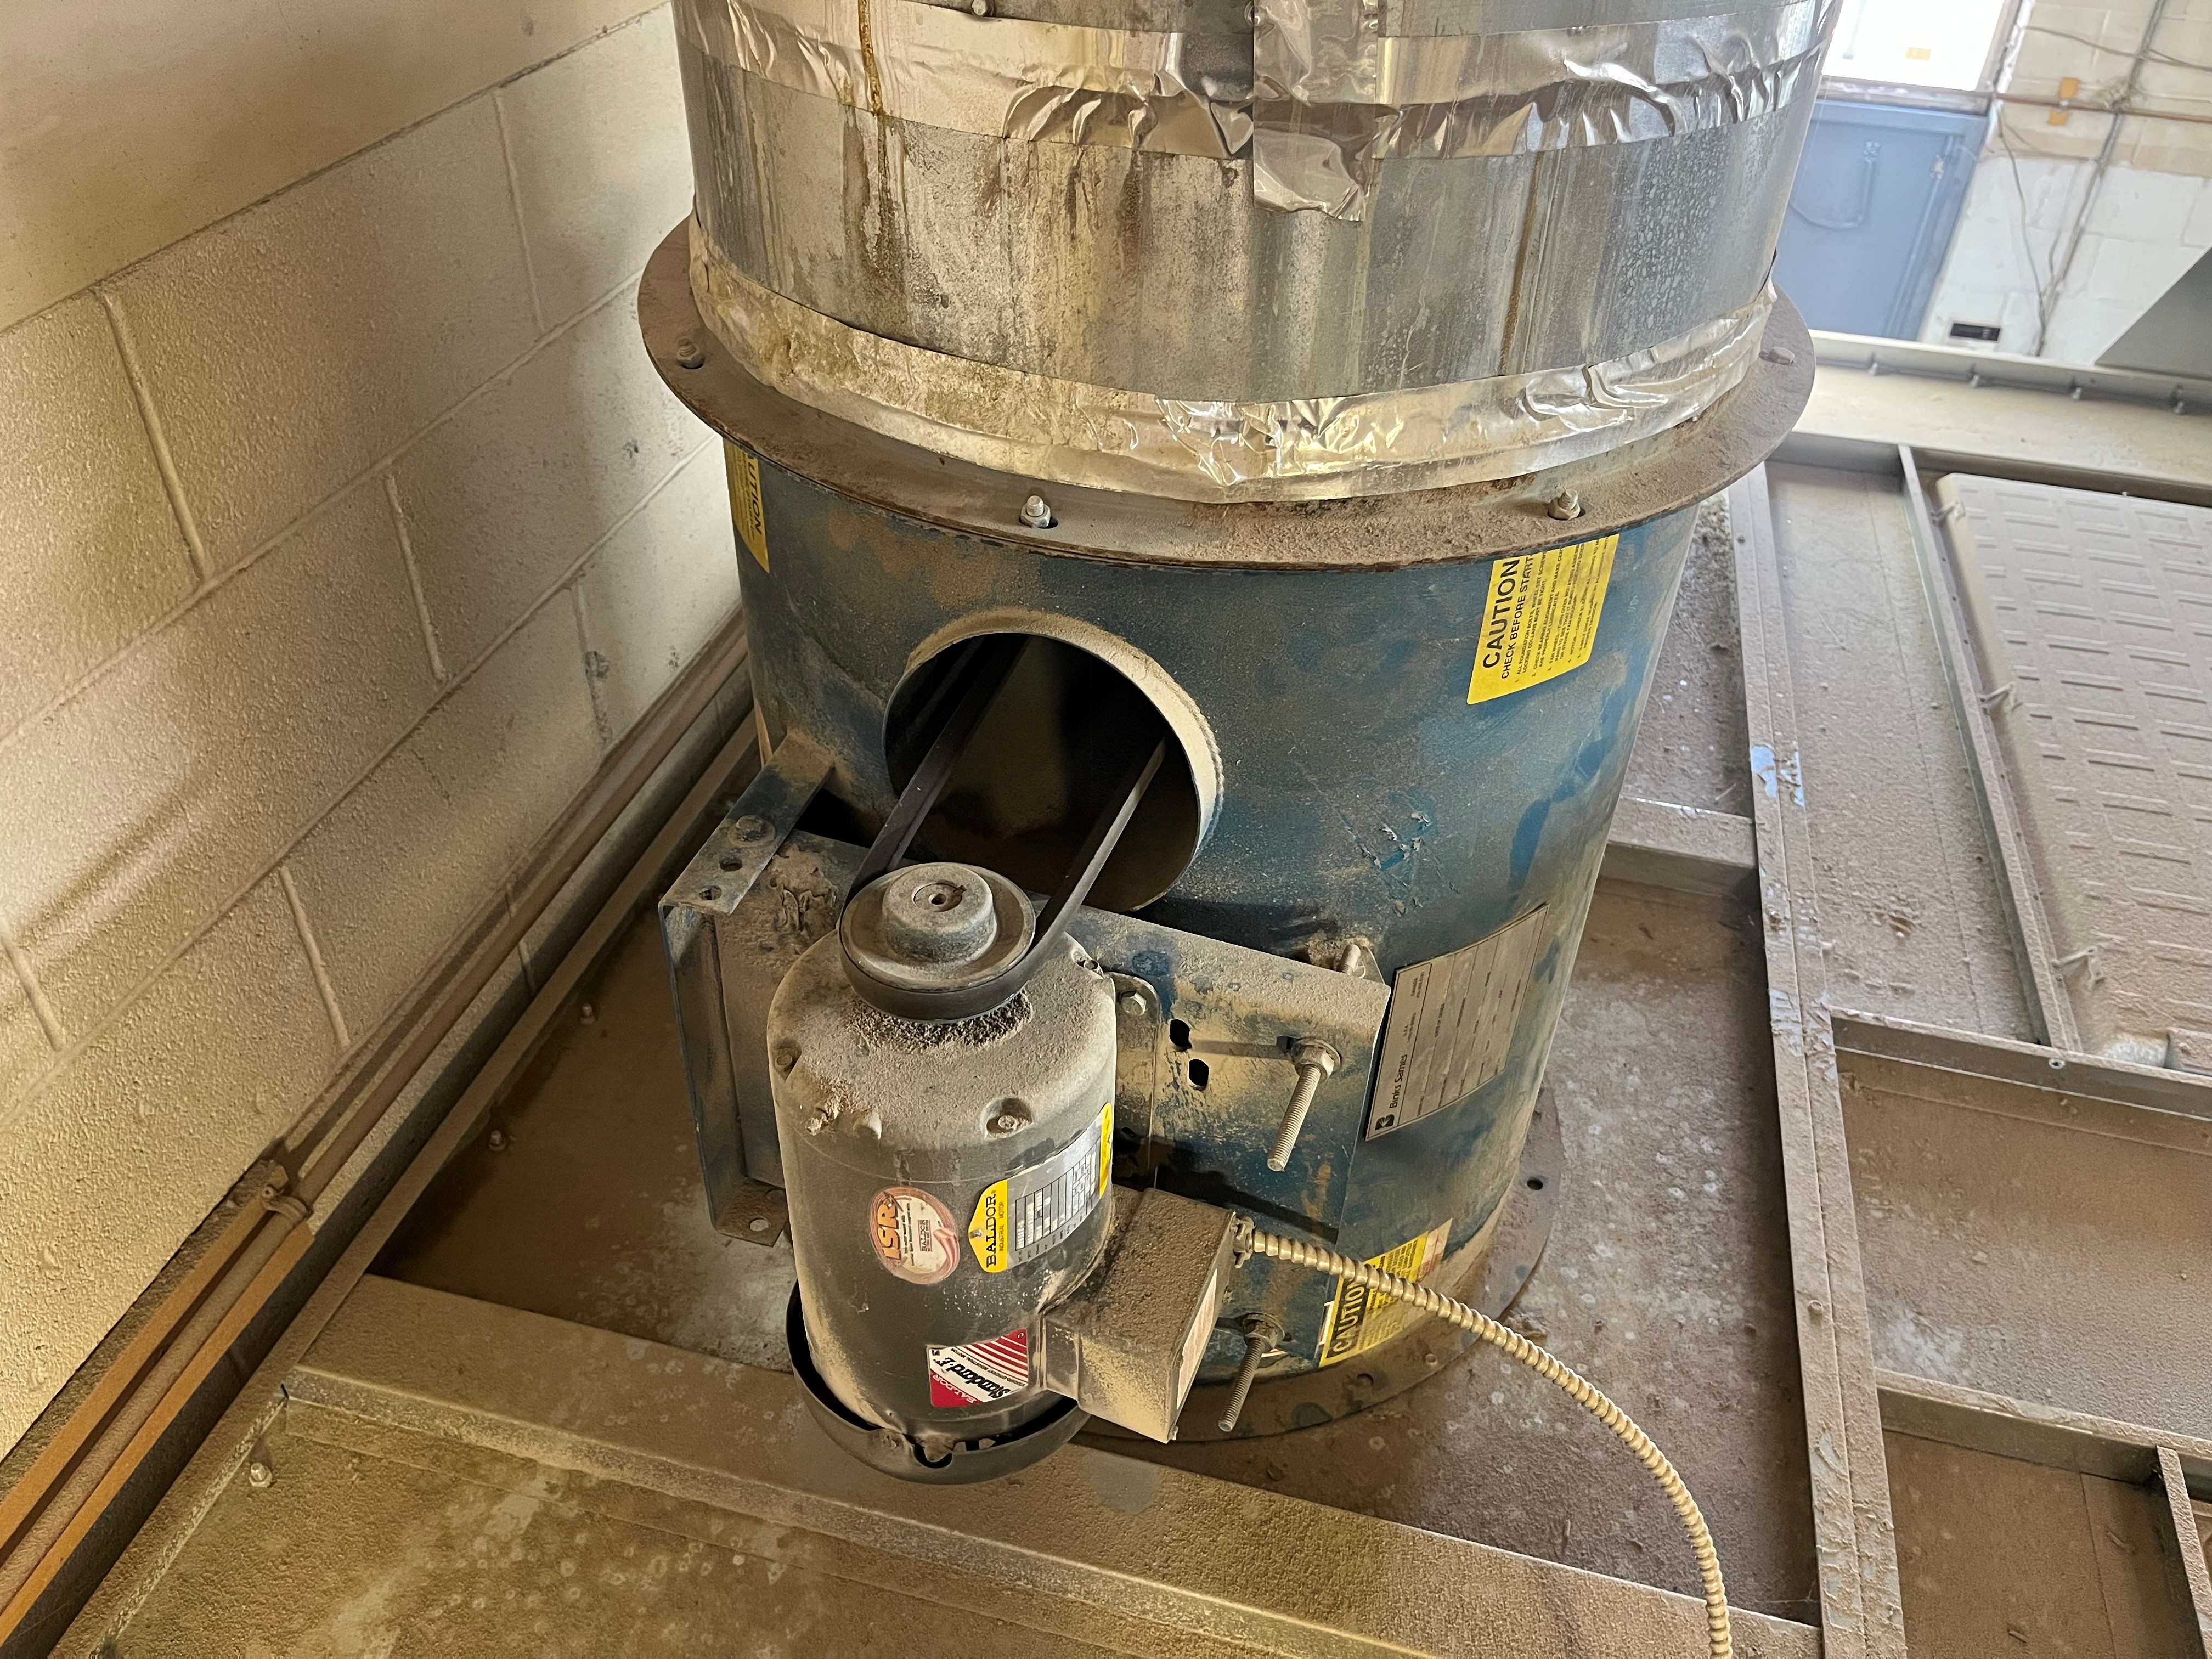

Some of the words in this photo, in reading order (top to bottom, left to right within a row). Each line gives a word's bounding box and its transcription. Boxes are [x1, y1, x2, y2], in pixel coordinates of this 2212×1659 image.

[1481, 558, 1520, 670] CAUTION
[1501, 642, 1515, 679] CHECK
[1509, 595, 1525, 640] BEFORE
[1389, 1084, 1401, 1108] Binks
[1395, 1054, 1408, 1084] Sames
[878, 1204, 901, 1260] ISR
[986, 1194, 996, 1268] BALDOR
[933, 1374, 977, 1403] BALDOR
[936, 1357, 1011, 1398] Standard-E
